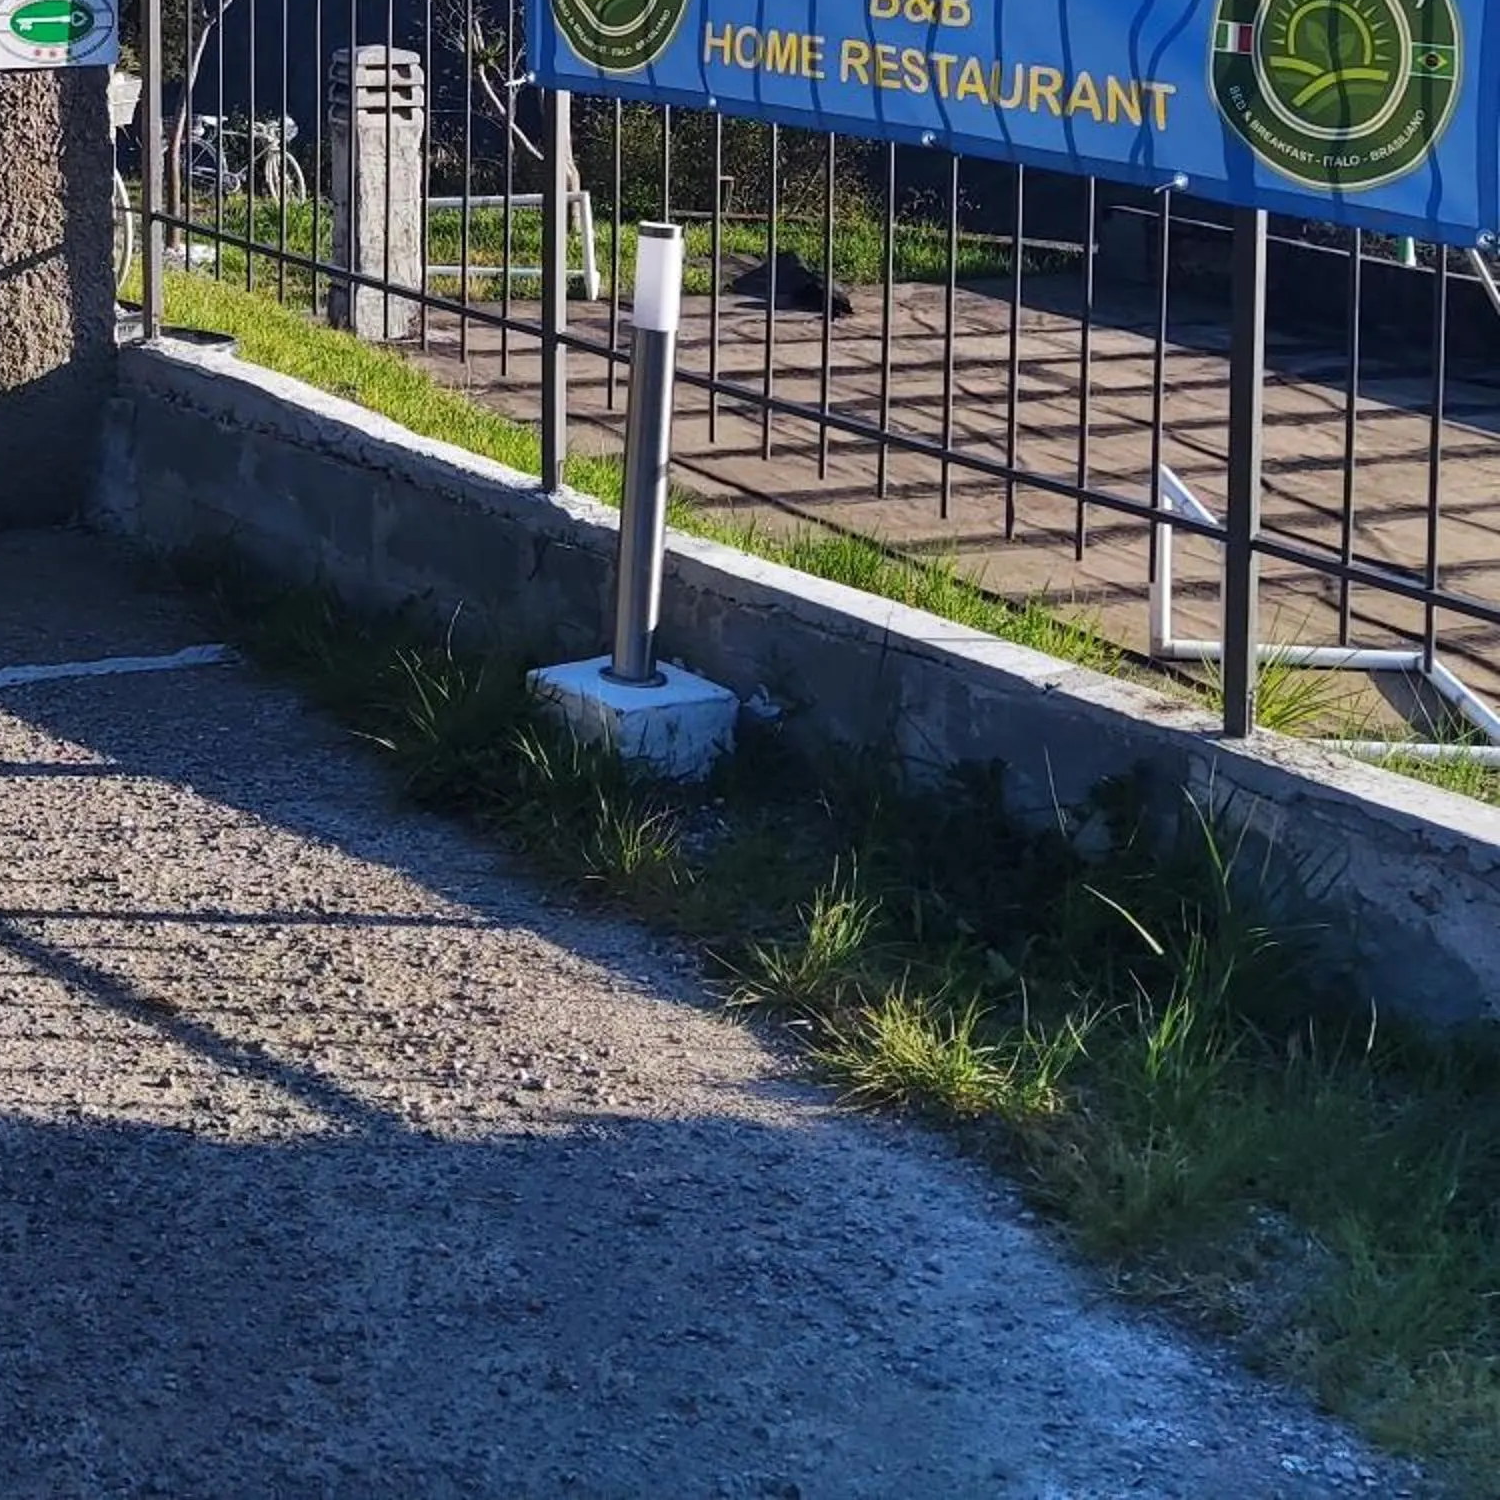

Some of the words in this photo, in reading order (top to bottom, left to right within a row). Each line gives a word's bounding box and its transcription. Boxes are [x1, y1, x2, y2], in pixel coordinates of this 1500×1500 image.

[703, 20, 826, 79] HOME
[839, 38, 1178, 132] RESTAURANT
[1249, 120, 1315, 165] BREAKFAST
[1322, 154, 1361, 168] ITALO
